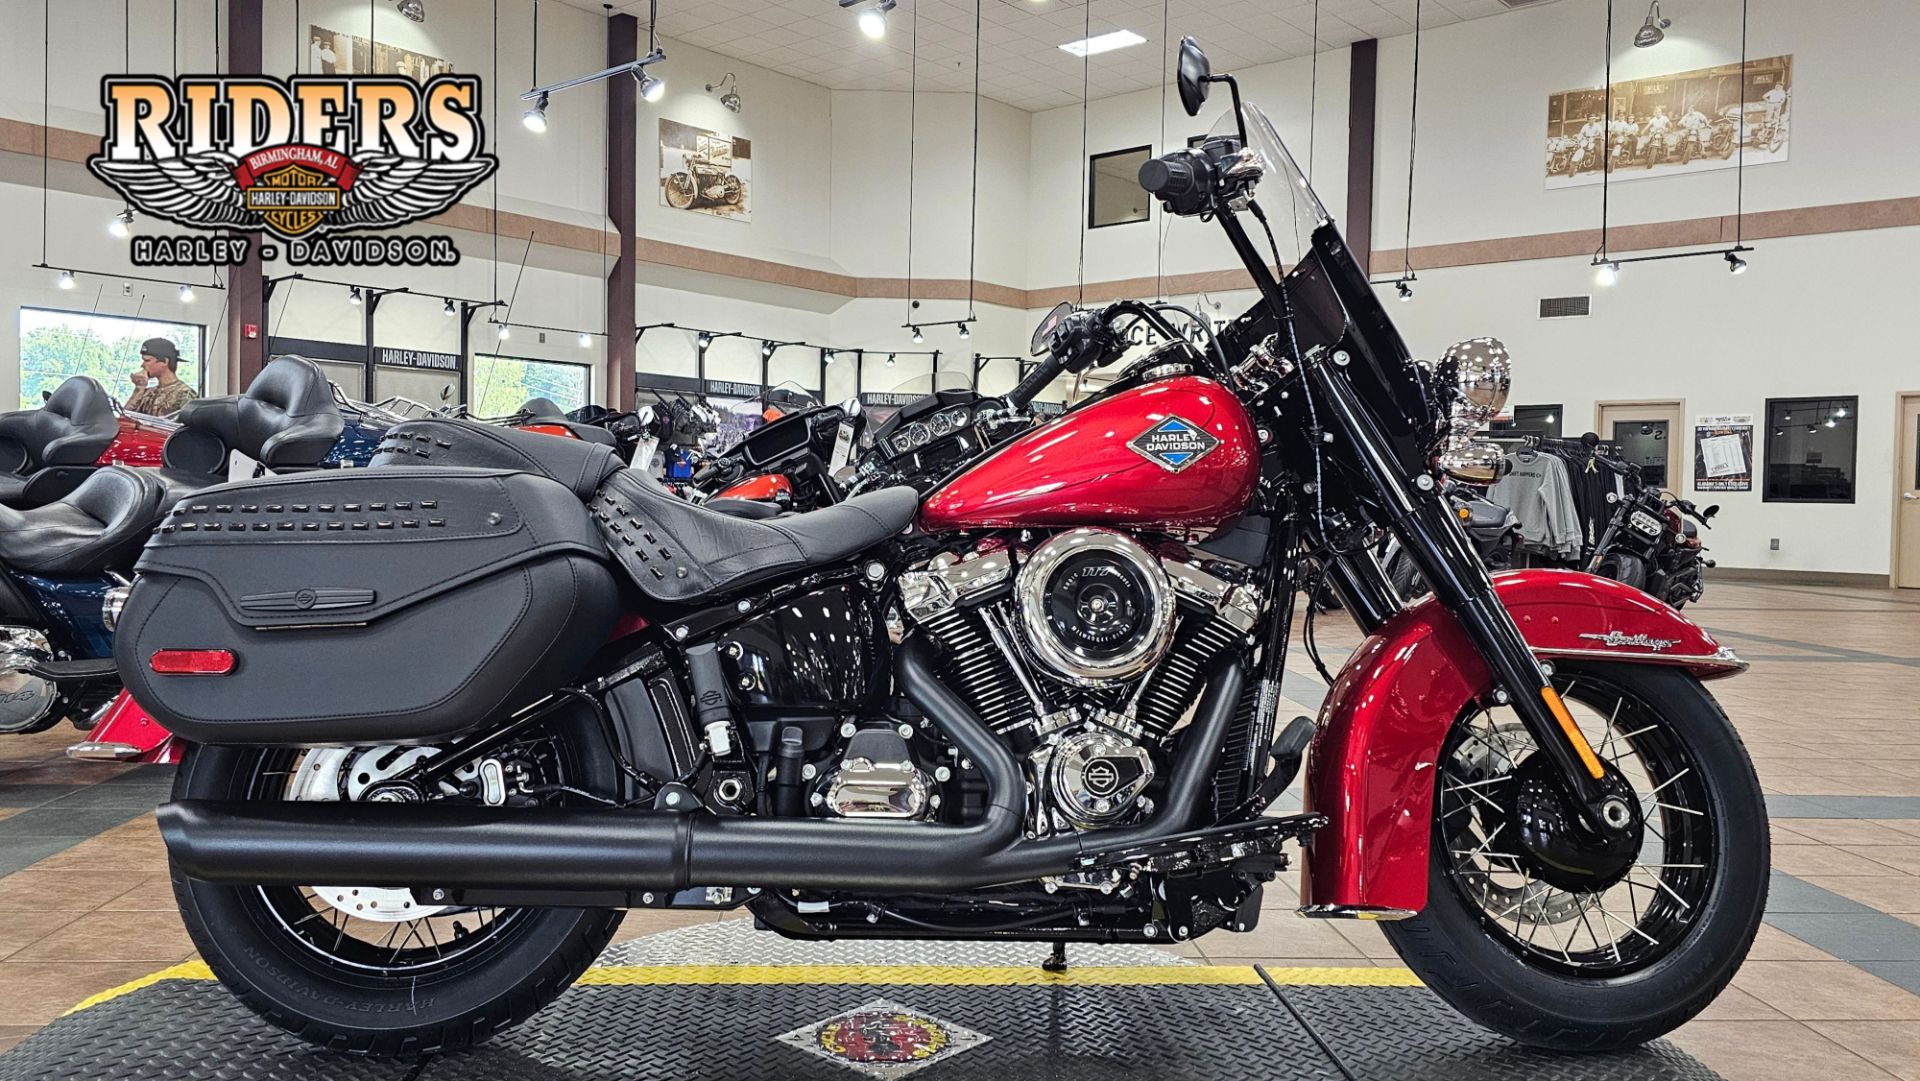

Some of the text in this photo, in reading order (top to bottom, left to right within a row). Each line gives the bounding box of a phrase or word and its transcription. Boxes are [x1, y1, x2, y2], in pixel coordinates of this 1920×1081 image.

[382, 348, 457, 370] HARLEY-DAVIDSON
[710, 381, 760, 396] HARLEY-DAVIDSON
[1151, 433, 1200, 443] HARLEY-
[1146, 442, 1206, 451] DAVIDSON
[1081, 566, 1113, 577] 117
